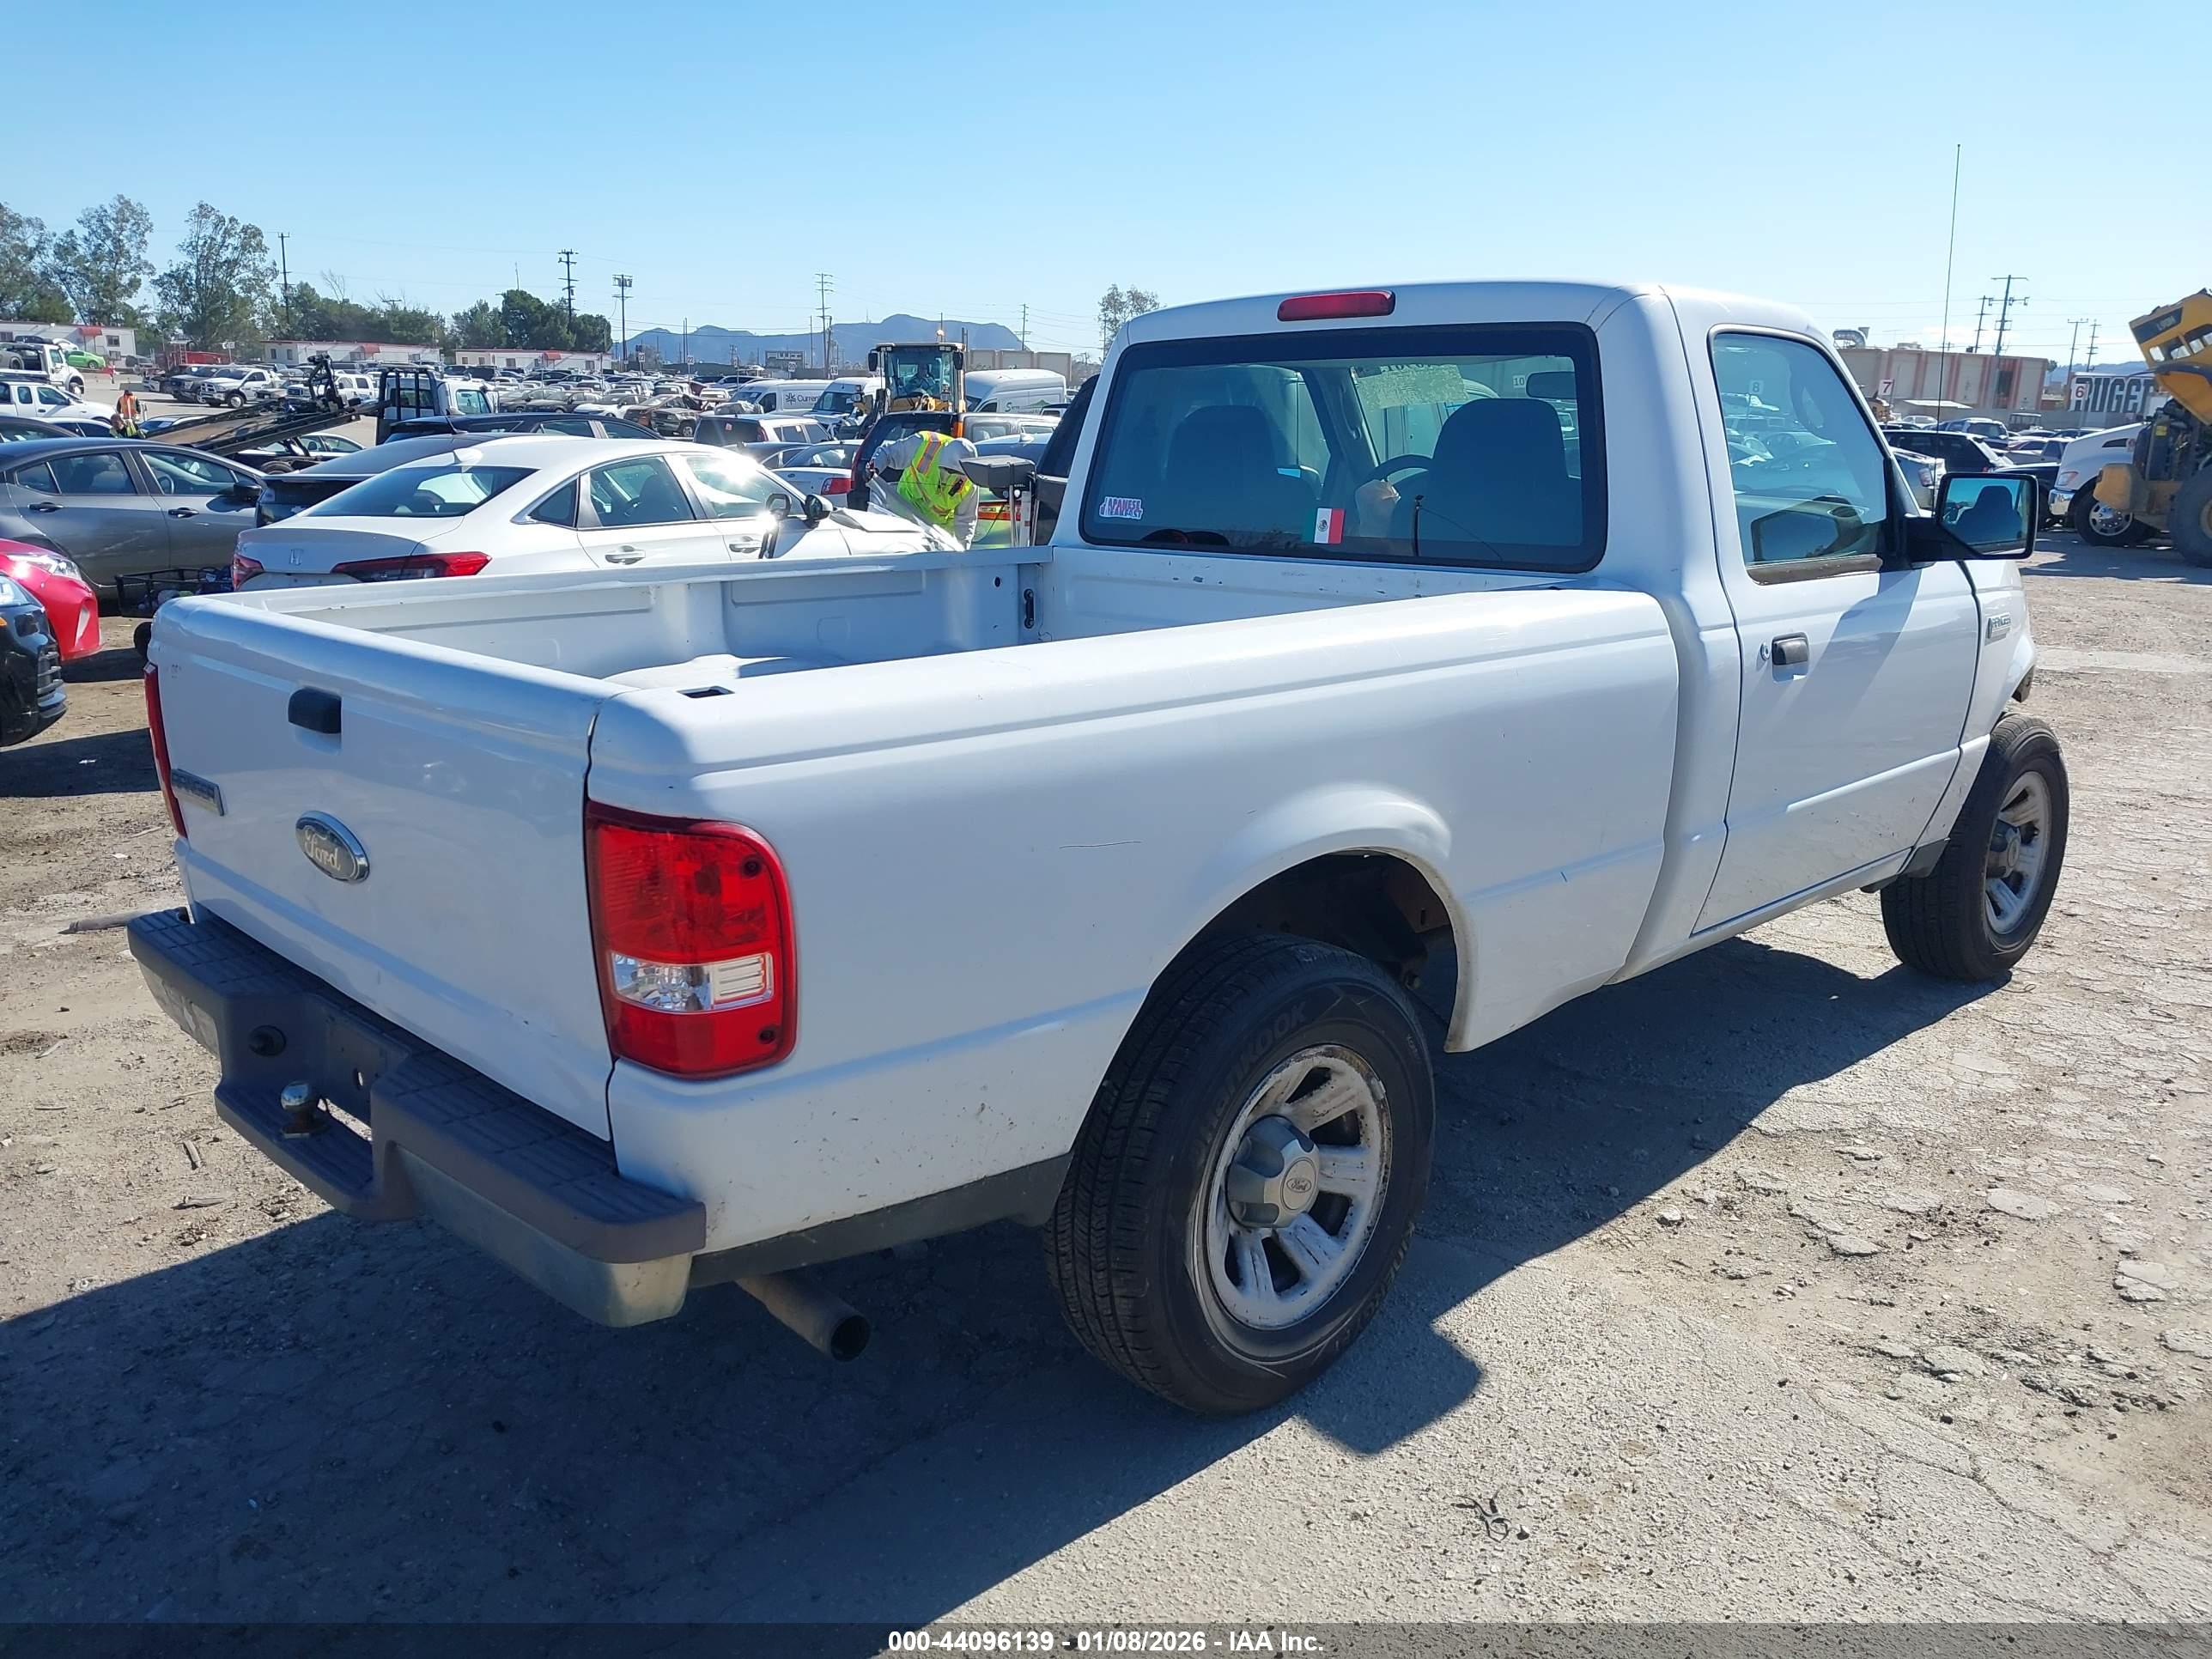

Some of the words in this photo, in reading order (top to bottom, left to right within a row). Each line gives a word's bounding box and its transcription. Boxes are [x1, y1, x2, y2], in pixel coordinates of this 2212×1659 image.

[1513, 377, 1525, 386] 10
[1753, 381, 1760, 393] 8
[1883, 381, 1893, 393] 7
[2075, 386, 2085, 398] 6
[797, 394, 820, 403] Curren
[304, 824, 341, 871] Ford
[1291, 1180, 1308, 1191] Ford
